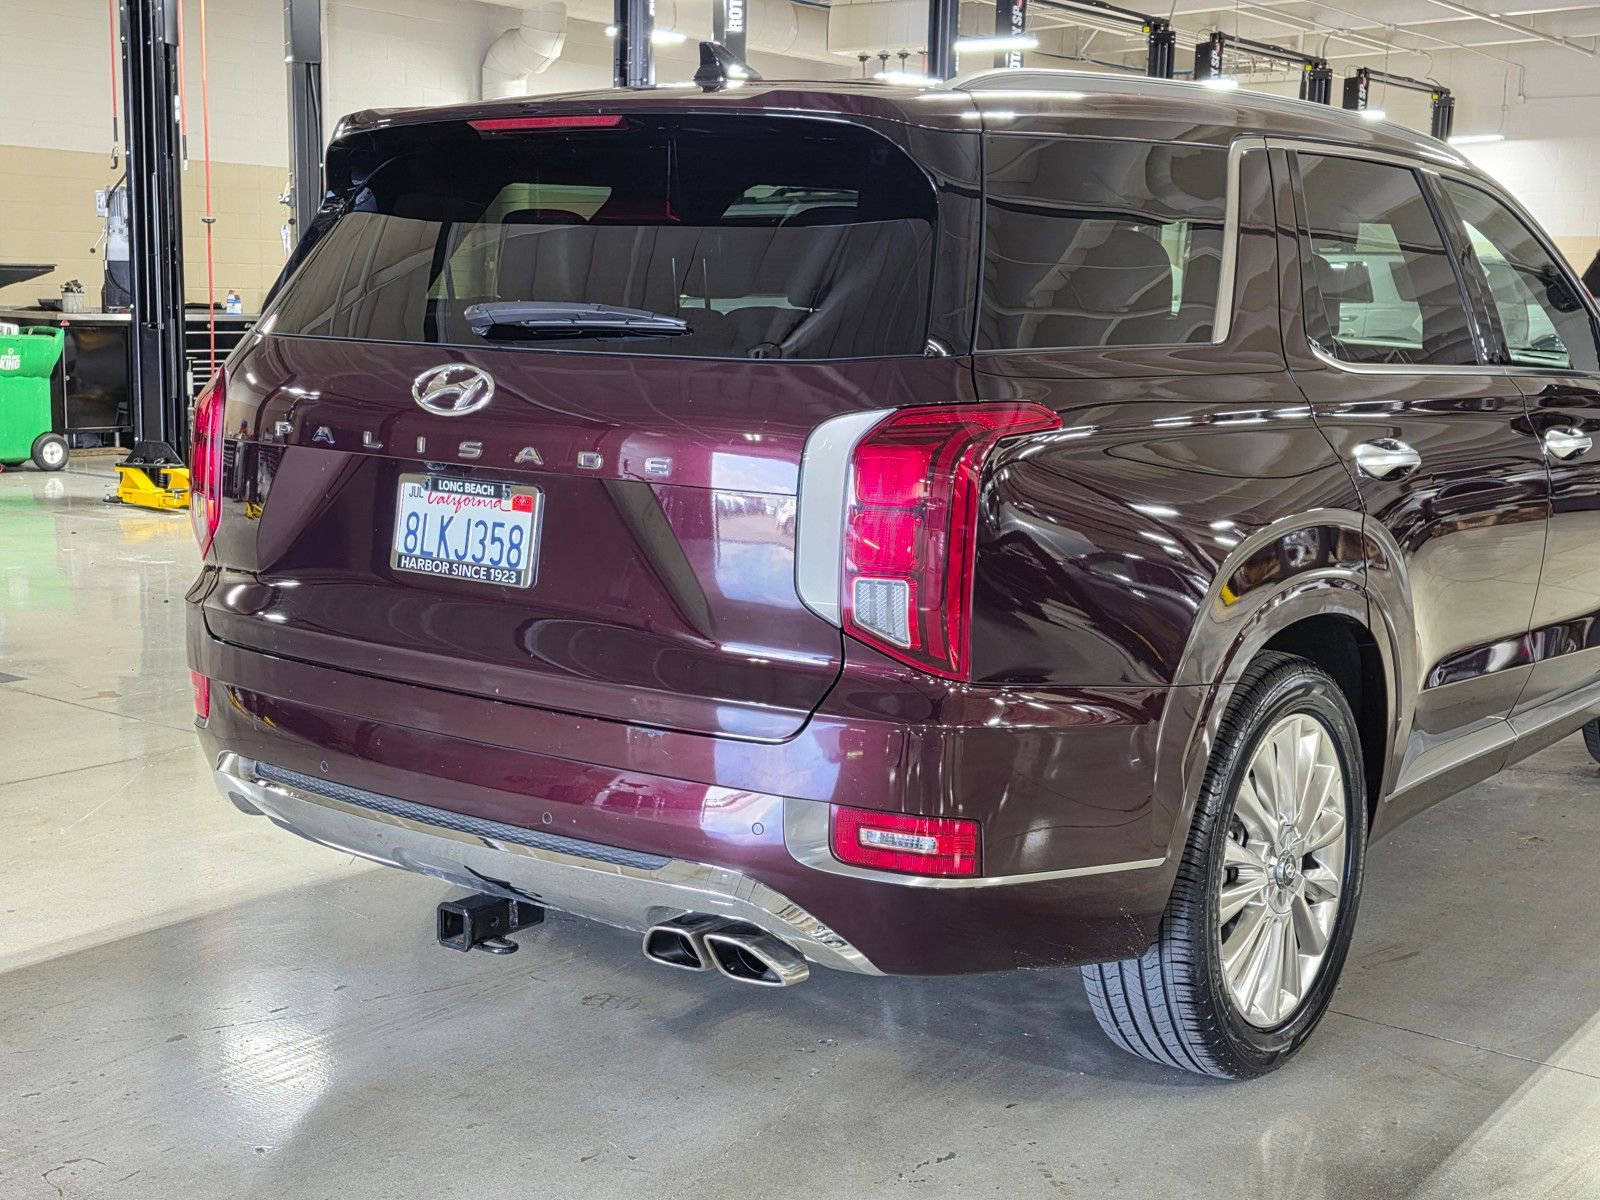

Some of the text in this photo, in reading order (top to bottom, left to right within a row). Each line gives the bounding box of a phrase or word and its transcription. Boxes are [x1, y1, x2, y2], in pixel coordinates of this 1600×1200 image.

[274, 421, 673, 476] PALISADE
[408, 485, 424, 498] JUL
[438, 479, 494, 496] LONG BEACH
[427, 491, 512, 513] California
[404, 511, 523, 569] 8LKJ358
[401, 556, 517, 583] HARBOR SINCE 1923
